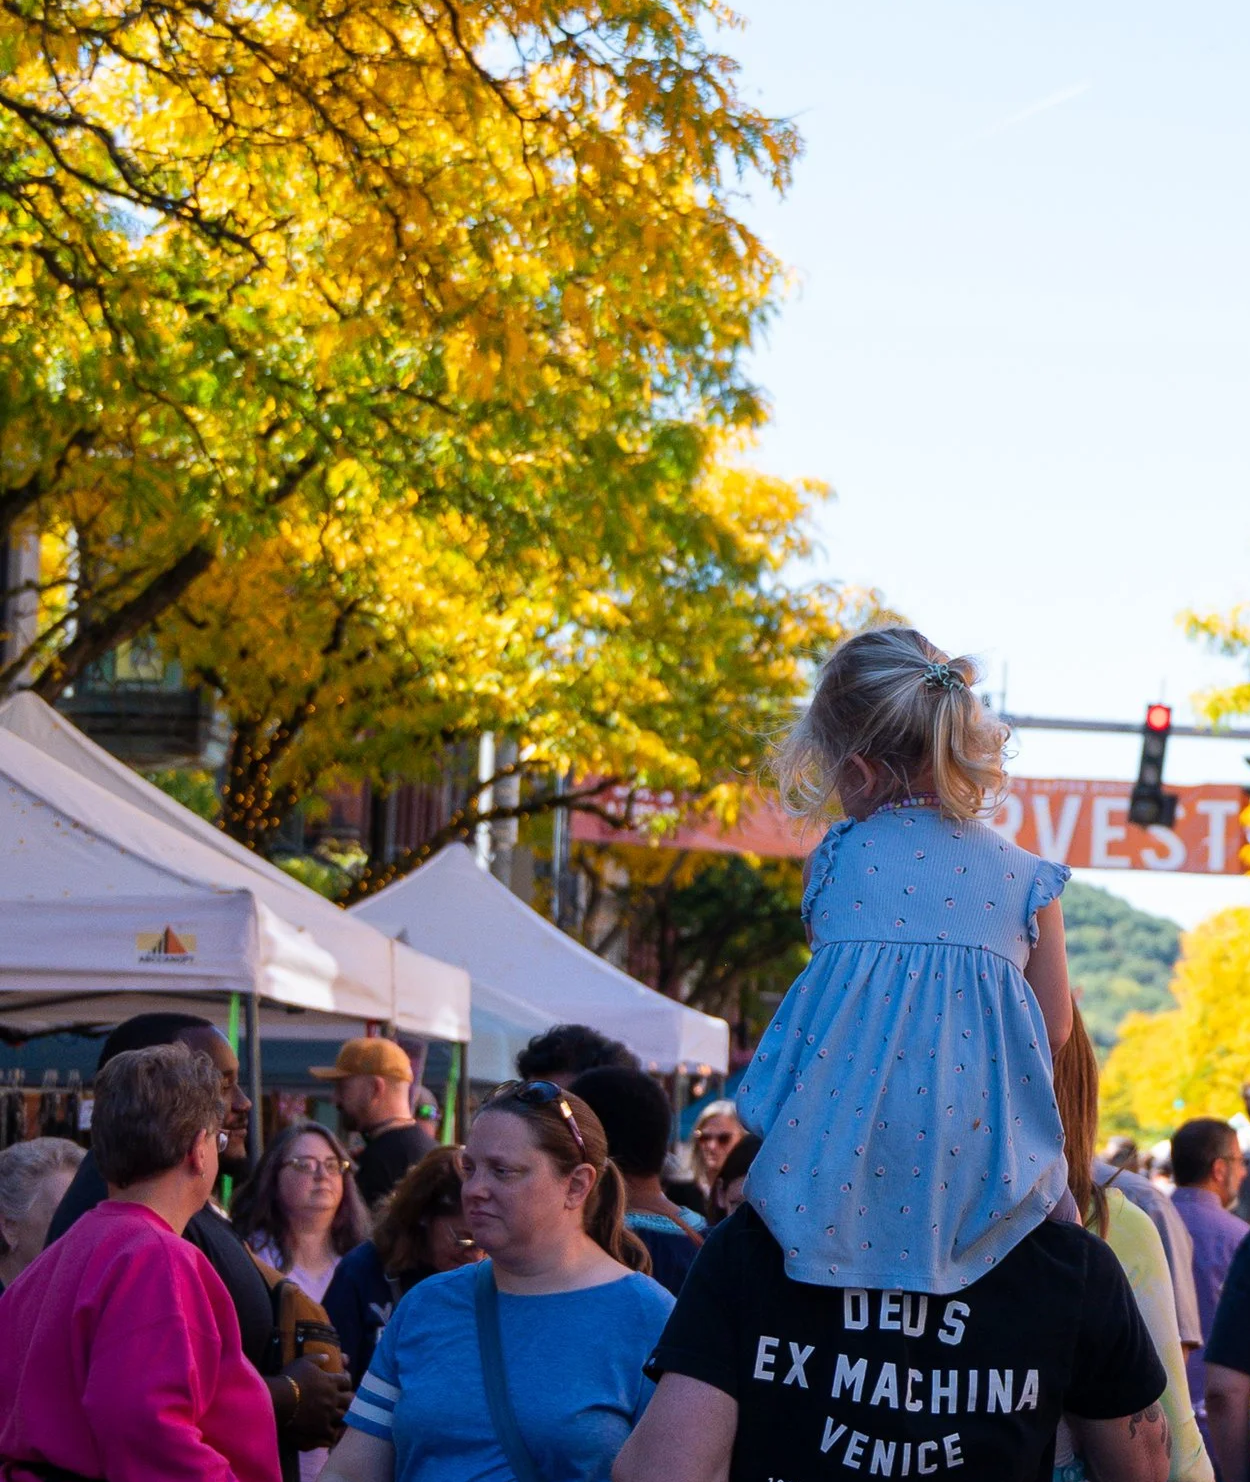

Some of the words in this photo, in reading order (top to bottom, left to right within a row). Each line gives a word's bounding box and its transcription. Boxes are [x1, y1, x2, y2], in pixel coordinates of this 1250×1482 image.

[989, 793, 1239, 872] RVEST
[844, 1287, 970, 1346] DEUS
[753, 1335, 815, 1389] EX
[831, 1353, 1039, 1414] MACHINA
[820, 1416, 964, 1477] VENICE
